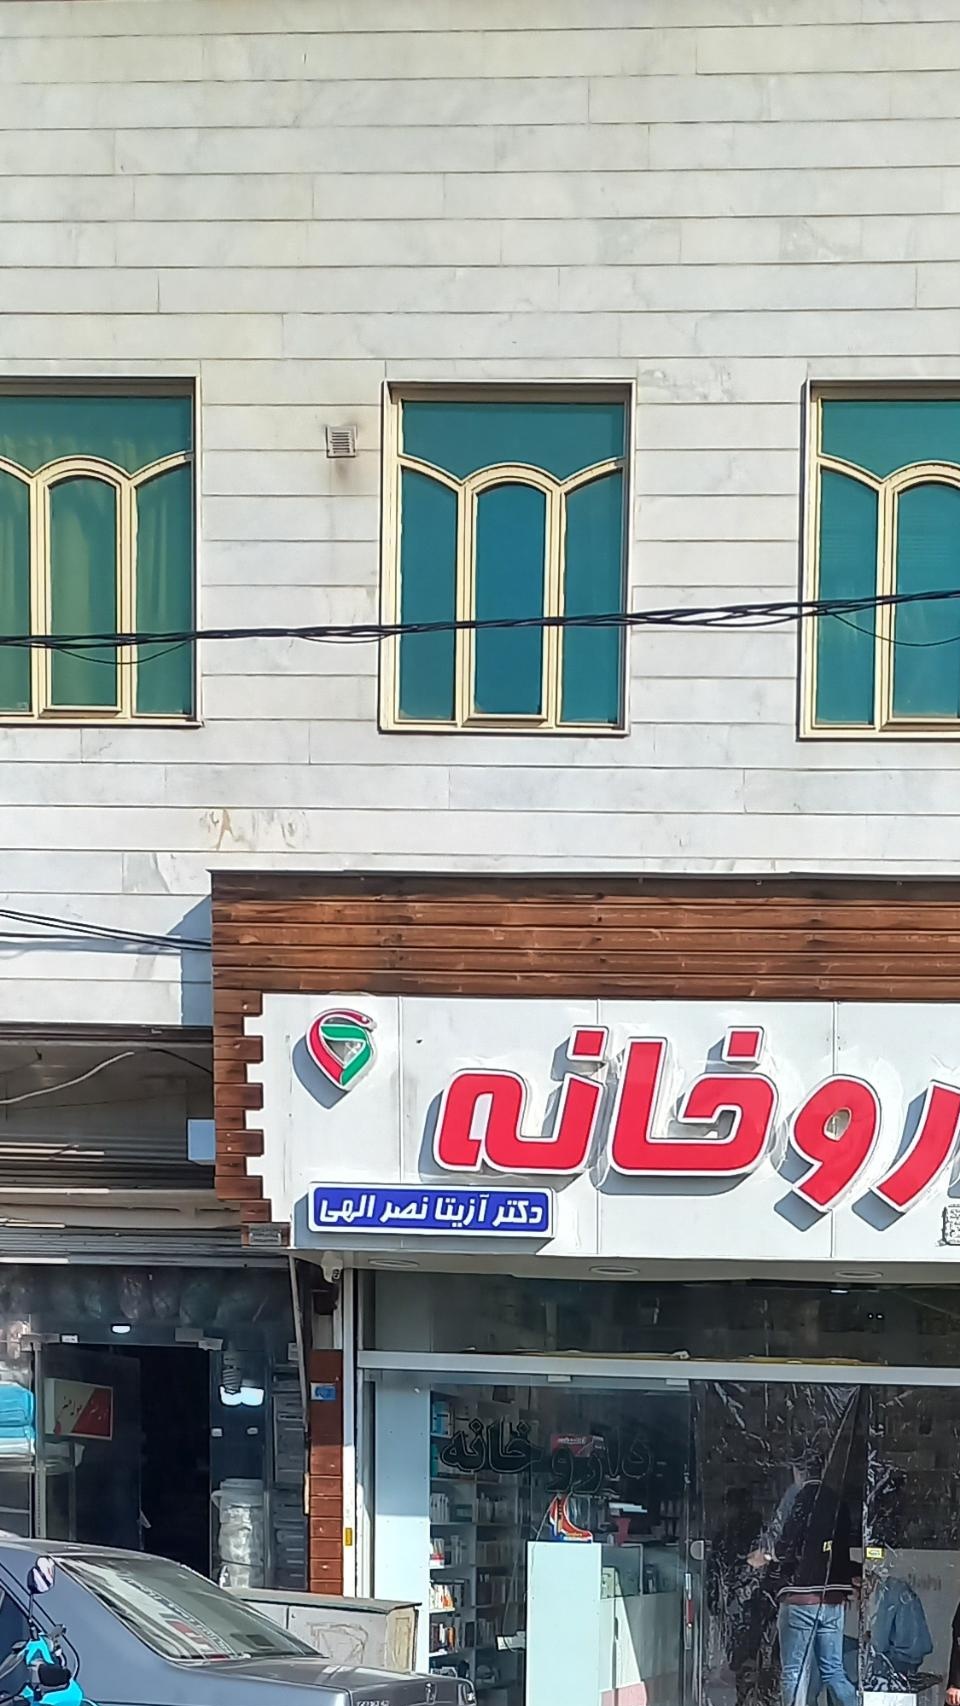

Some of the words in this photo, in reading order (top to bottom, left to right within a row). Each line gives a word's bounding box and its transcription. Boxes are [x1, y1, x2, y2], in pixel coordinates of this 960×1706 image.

[318, 1193, 377, 1224] الهی
[379, 1195, 429, 1224] نصر
[433, 1193, 490, 1228] آزیتا
[492, 1198, 544, 1228] دکتر
